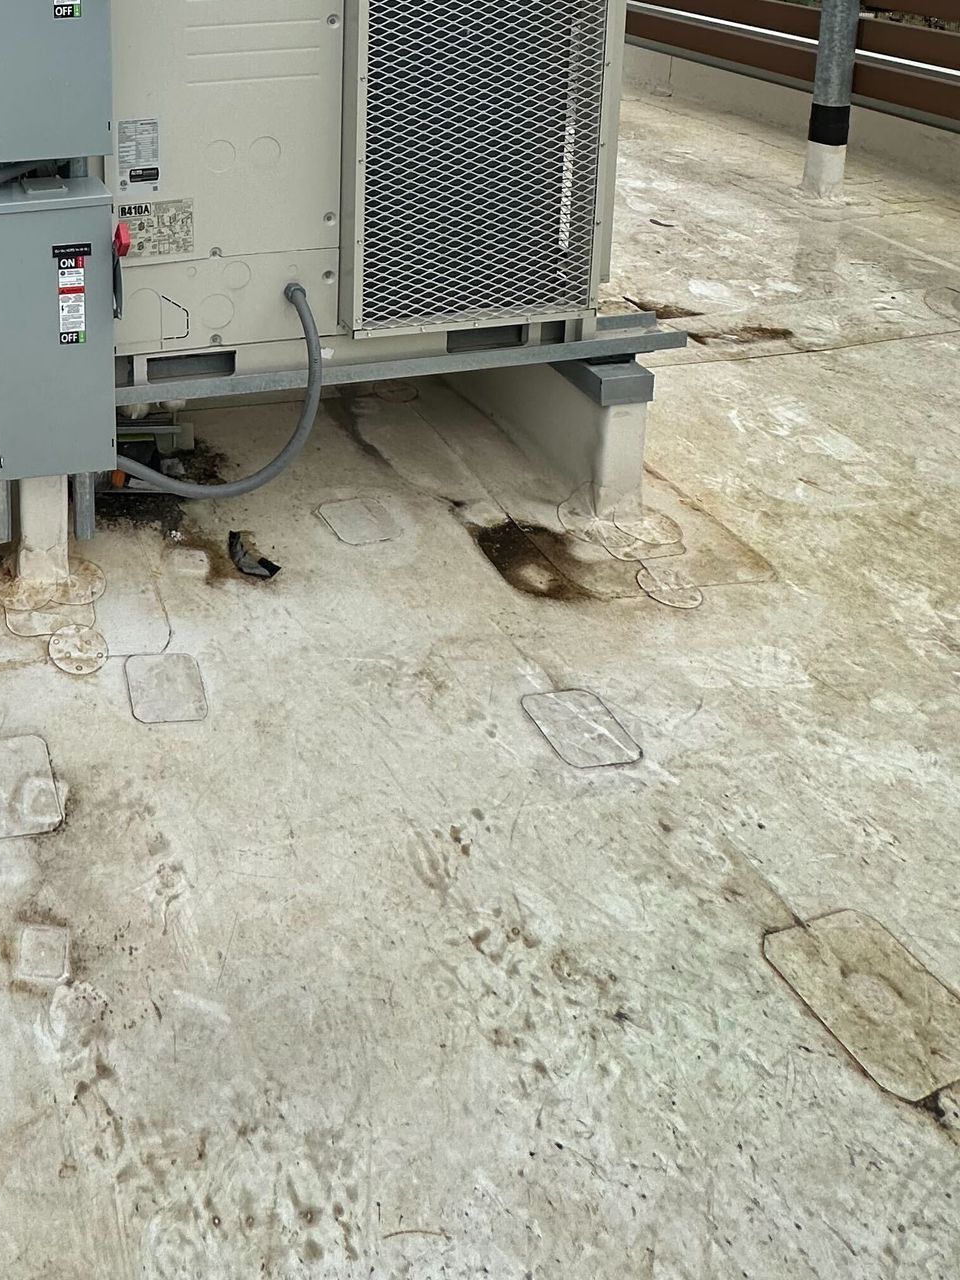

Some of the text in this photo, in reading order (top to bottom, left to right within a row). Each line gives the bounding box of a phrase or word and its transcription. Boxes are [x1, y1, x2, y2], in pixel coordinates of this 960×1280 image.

[55, 6, 73, 16] OFF
[120, 205, 150, 217] R410A
[60, 258, 75, 268] ON
[61, 333, 78, 343] OFF
